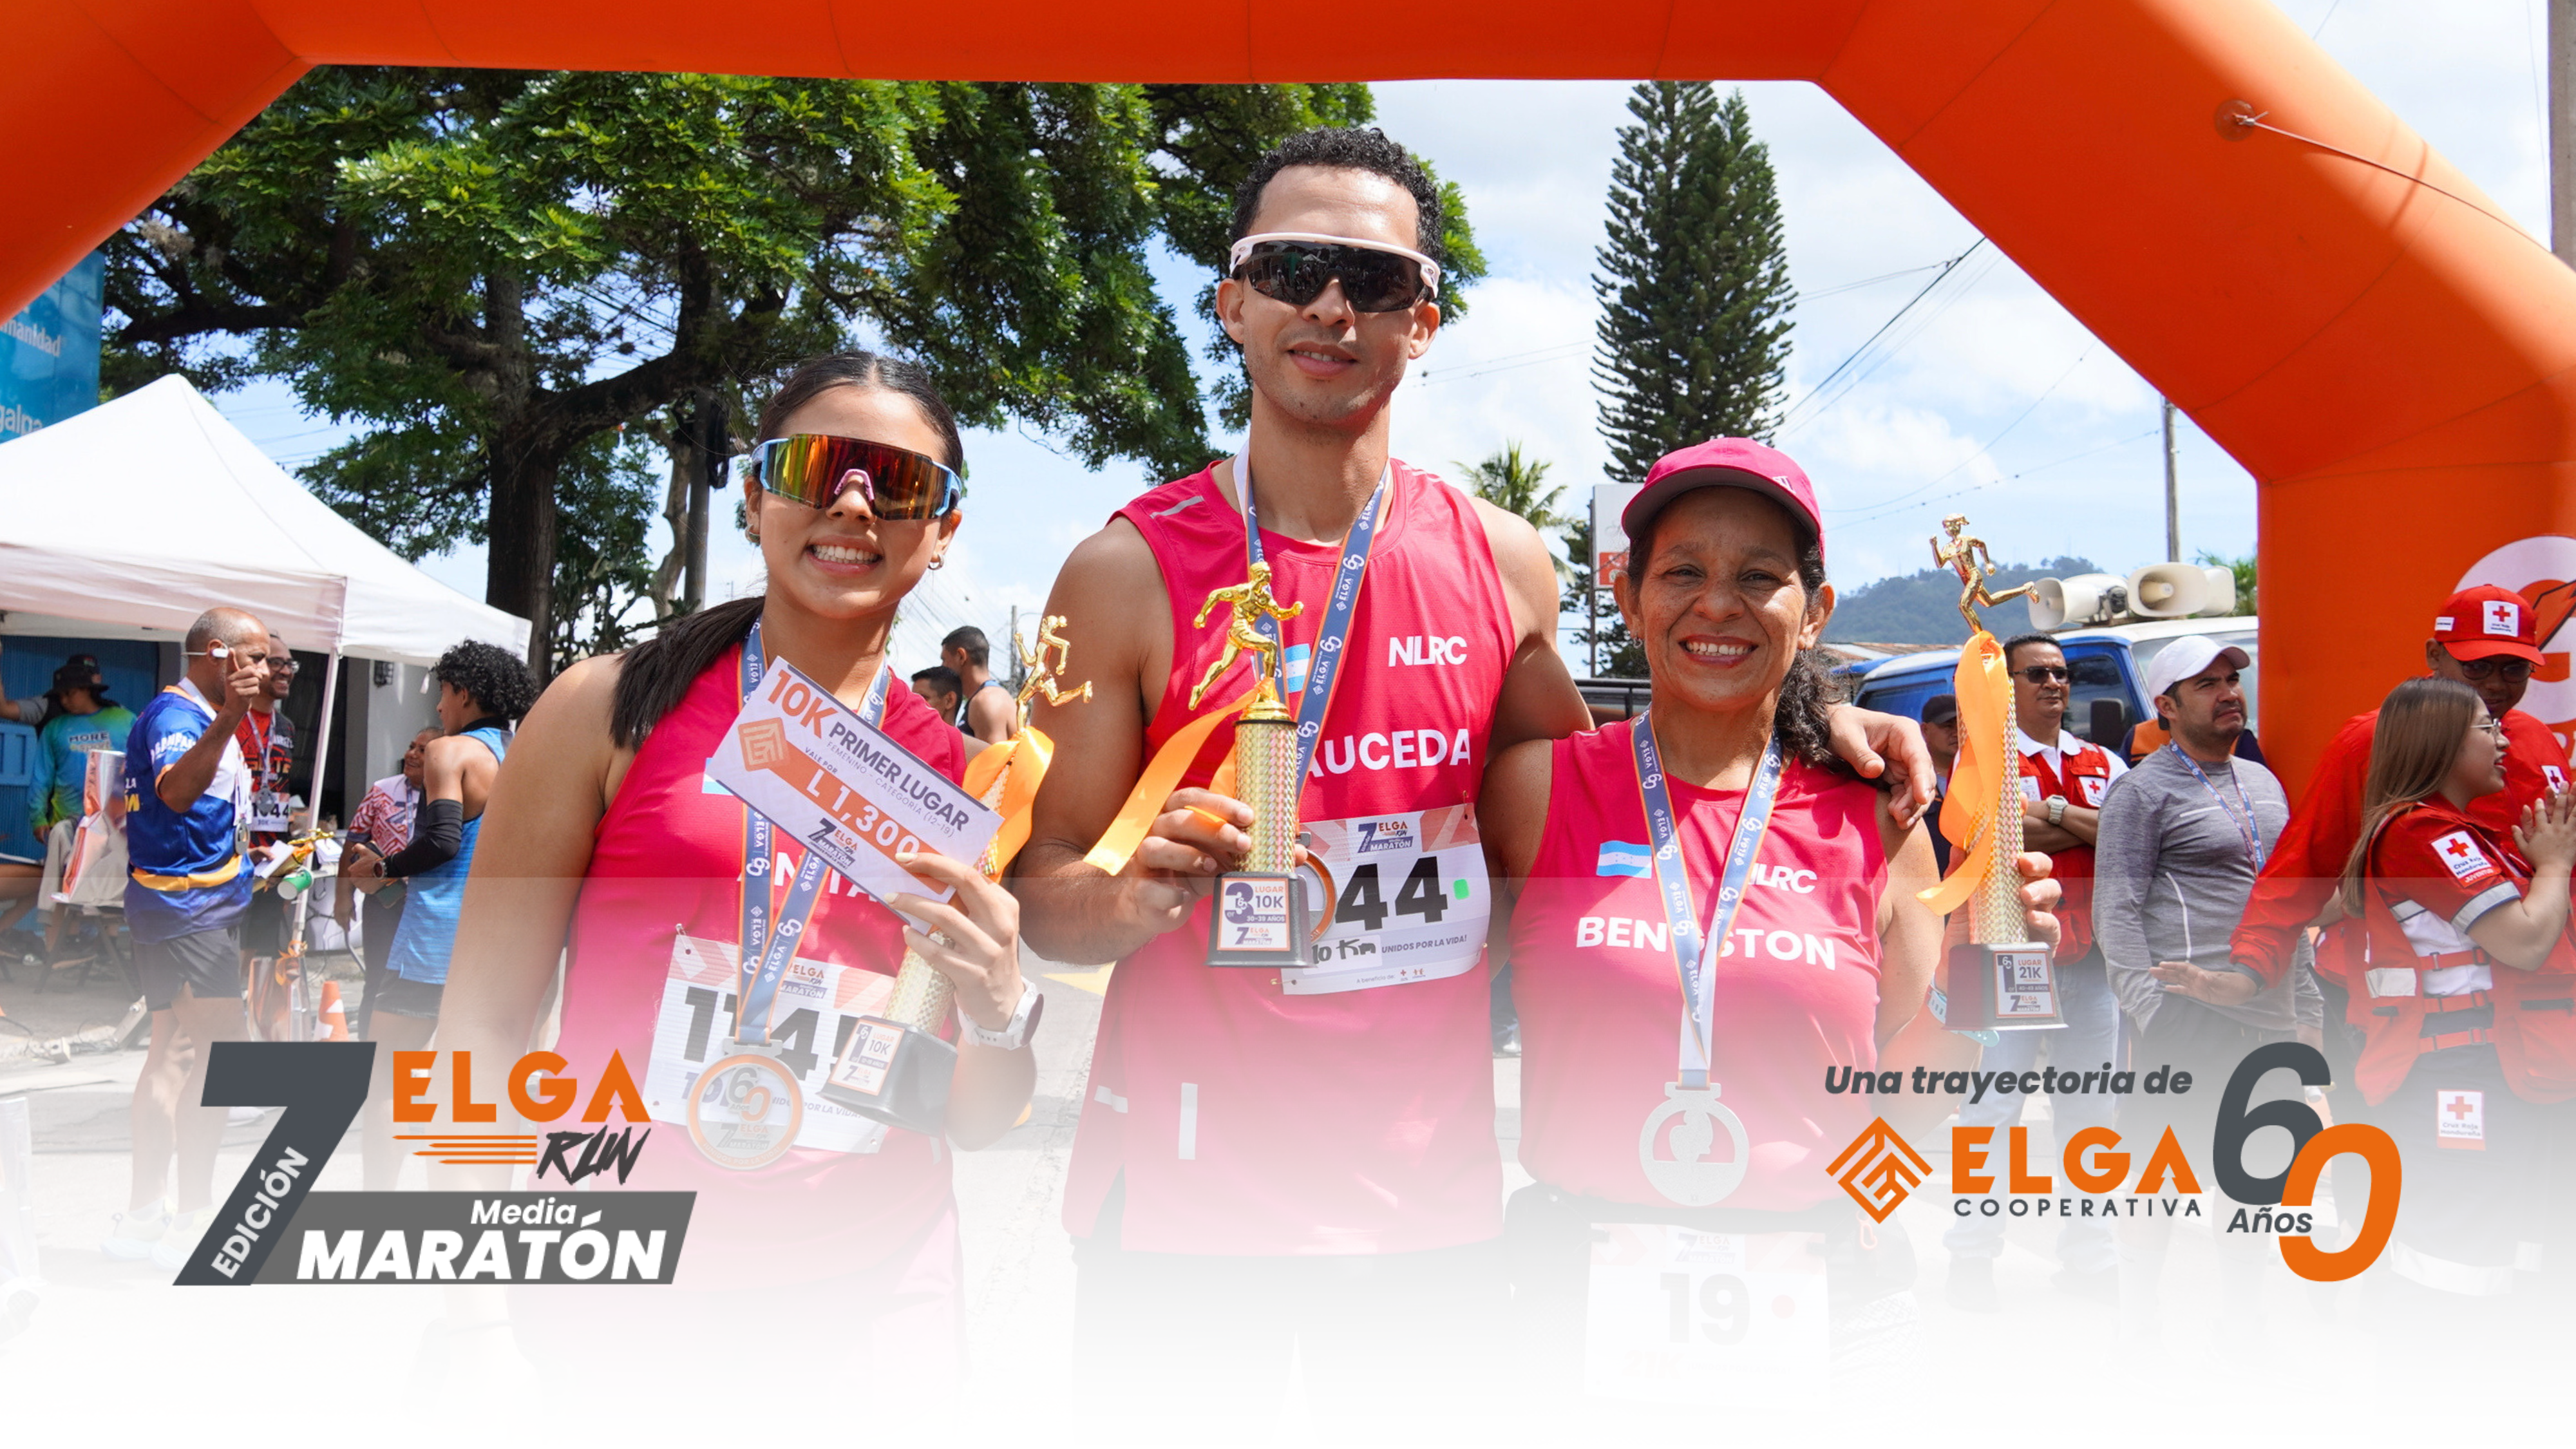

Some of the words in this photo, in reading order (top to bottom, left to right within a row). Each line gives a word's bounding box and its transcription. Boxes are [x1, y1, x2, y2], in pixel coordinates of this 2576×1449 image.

[1388, 636, 1467, 667] NLRC
[768, 669, 838, 739] 10K
[69, 733, 108, 743] MORE
[805, 746, 822, 764] VALE
[822, 760, 838, 774] POR
[826, 742, 867, 773] FEMENINO
[875, 778, 921, 815] CATEGORÍA
[829, 721, 902, 784] PRIMER
[899, 773, 969, 831] LUGAR
[806, 768, 824, 797] L
[831, 785, 920, 853] 1,300
[1379, 820, 1408, 831] ELGA
[835, 829, 857, 851] ELGA
[1370, 840, 1412, 852] MARATÓN
[1255, 895, 1283, 908] 10K
[1335, 856, 1448, 931] 44
[1235, 927, 1249, 945] 7
[1381, 943, 1414, 954] UNIDOS
[1416, 941, 1433, 949] POR
[1434, 938, 1444, 947] LA
[1446, 934, 1467, 945] VIDA!
[793, 964, 824, 979] ELGA
[2019, 967, 2041, 978] 21K
[869, 1039, 891, 1055] 10K
[730, 1066, 772, 1122] 60
[741, 1124, 769, 1133] ELGA
[1660, 1272, 1750, 1346] 19
